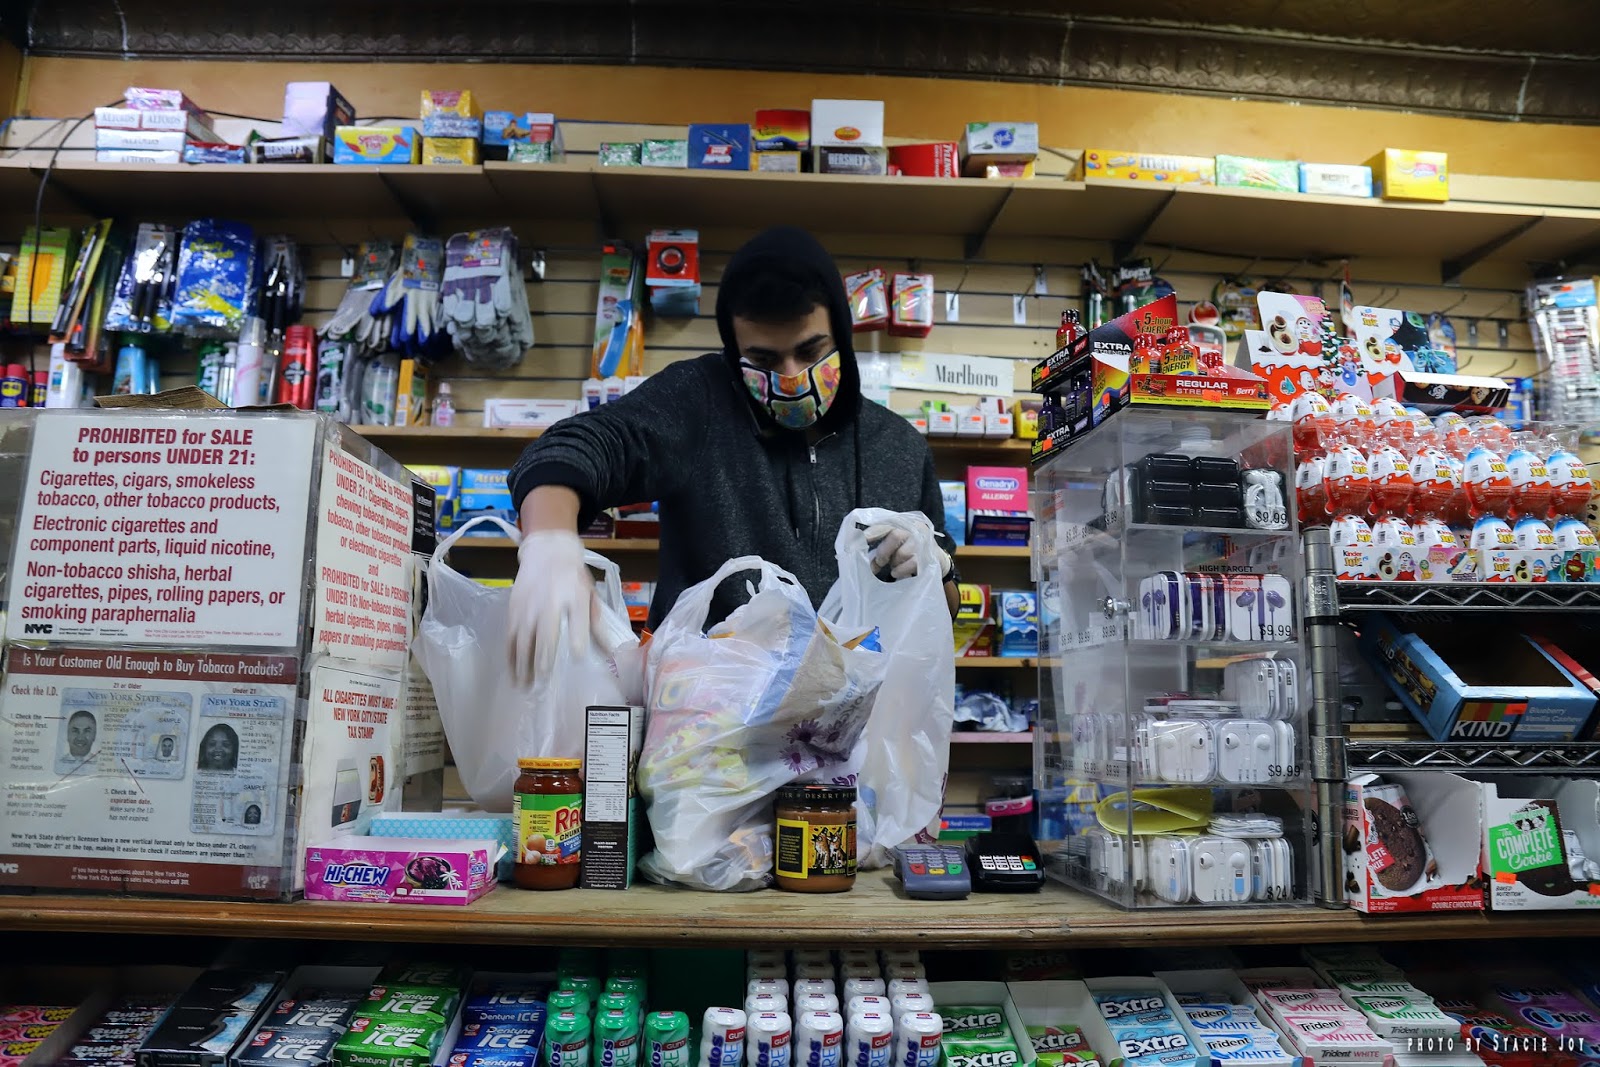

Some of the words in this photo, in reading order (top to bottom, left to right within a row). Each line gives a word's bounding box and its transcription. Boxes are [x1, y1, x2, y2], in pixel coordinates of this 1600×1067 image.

[1144, 313, 1173, 325] 5-hour
[1094, 342, 1131, 351] EXTRA
[1047, 348, 1070, 367] EXTRA
[1164, 350, 1193, 365] 5-hour
[1162, 360, 1191, 374] ENERGY
[936, 364, 998, 387] Marlboro
[1176, 380, 1228, 389] REGULAR
[1236, 387, 1255, 395] Berry
[78, 427, 176, 445] PROHIBITED
[182, 429, 206, 445] for
[210, 430, 253, 446] SALE
[73, 448, 89, 462] to
[94, 449, 161, 466] persons
[167, 449, 223, 465] UNDER
[229, 450, 255, 465] 21:
[329, 450, 364, 480] PROHIBITED
[375, 474, 387, 492] SALE
[40, 470, 118, 490] Cigarettes,
[123, 472, 172, 490] cigars,
[176, 473, 255, 489] smokeless
[337, 473, 357, 495] UNDER
[979, 479, 1015, 490] Benadryl
[37, 492, 100, 509] tobacco,
[104, 493, 142, 508] other
[147, 493, 205, 509] tobacco
[209, 494, 280, 513] products,
[982, 493, 1014, 501] ALLERGY
[1255, 511, 1287, 524] $9.99
[33, 515, 107, 532] Electronic
[111, 517, 185, 535] cigarettes
[190, 518, 217, 534] and
[30, 538, 114, 555] component
[118, 540, 160, 556] parts,
[165, 539, 205, 558] liquid
[211, 540, 275, 559] nicotine,
[26, 562, 123, 580] Non-tobacco
[127, 564, 180, 583] shisha,
[185, 565, 232, 582] herbal
[322, 566, 359, 589] PROHIBITED
[361, 577, 369, 591] for
[371, 580, 383, 595] SALE
[24, 583, 103, 602] cigarettes,
[108, 586, 152, 603] pipes,
[156, 586, 203, 605] rolling
[208, 589, 264, 607] papers,
[269, 590, 285, 604] or
[326, 587, 347, 605] UNDER
[21, 604, 87, 624] smoking
[92, 606, 196, 625] paraphernalia
[25, 624, 52, 634] NYC
[1260, 624, 1291, 637] $9.99
[23, 653, 31, 666] Is
[35, 653, 56, 667] Your
[60, 655, 103, 668] Customer
[106, 656, 122, 670] Old
[125, 656, 160, 674] Enough
[163, 660, 173, 671] to
[176, 659, 194, 676] Buy
[198, 660, 234, 674] Tobacco
[238, 661, 284, 676] Products?
[12, 684, 30, 695] Check
[33, 686, 44, 696] the
[46, 686, 58, 696] I.D.
[208, 698, 228, 706] NEW
[229, 698, 251, 706] YORK
[253, 700, 278, 708] STATE
[323, 689, 333, 702] ALL
[335, 690, 367, 706] CIGARETTES
[368, 695, 381, 708] MUST
[382, 697, 394, 709] HAVE
[334, 707, 346, 721] NEW
[347, 709, 361, 722] YORK
[362, 710, 387, 724] CITY/STATE
[348, 726, 357, 738] TAX
[358, 726, 374, 739] STAMP
[1451, 721, 1512, 737] KIND
[1268, 764, 1300, 777] $9.99
[555, 808, 582, 836] RA
[1499, 828, 1512, 836] The
[1497, 828, 1555, 859] COMPLETE
[1509, 851, 1553, 869] Cookie
[324, 865, 390, 886] HI-CHEW
[1363, 984, 1414, 992] WHITE
[391, 992, 440, 1000] Dentyne
[1274, 992, 1314, 1002] Trident
[298, 1004, 347, 1013] Dentyne
[379, 999, 436, 1014] ICE
[1100, 997, 1164, 1018] Extra
[1297, 1004, 1350, 1012] WHITE
[1367, 1000, 1408, 1010] Trident
[285, 1012, 343, 1027] ICE
[480, 1013, 515, 1023] Dentyne
[517, 1012, 540, 1021] ICE
[1186, 1009, 1229, 1019] Trident
[1391, 1011, 1444, 1019] WHITE
[374, 1023, 425, 1033] Dentyne
[486, 1026, 535, 1035] Dentyne
[1207, 1022, 1262, 1030] WHITE
[1300, 1020, 1343, 1032] Trident
[1391, 1026, 1419, 1034] Trident
[275, 1036, 328, 1045] Dentyne
[361, 1031, 421, 1048] ICE
[477, 1033, 532, 1048] ICE
[728, 1031, 744, 1039] GUM
[774, 1035, 790, 1045] GUM
[1323, 1034, 1379, 1042] WHITE
[567, 1041, 584, 1050] GUM
[666, 1041, 685, 1049] GUM
[1119, 1034, 1188, 1057] Extra
[1207, 1038, 1250, 1049] Trident
[262, 1044, 323, 1060] ICE
[1228, 1051, 1286, 1059] WHITE
[1321, 1050, 1352, 1058] Trident
[350, 1054, 388, 1065] Dentyne
[389, 1057, 414, 1067] ICE
[472, 1058, 524, 1067] Dentyne
